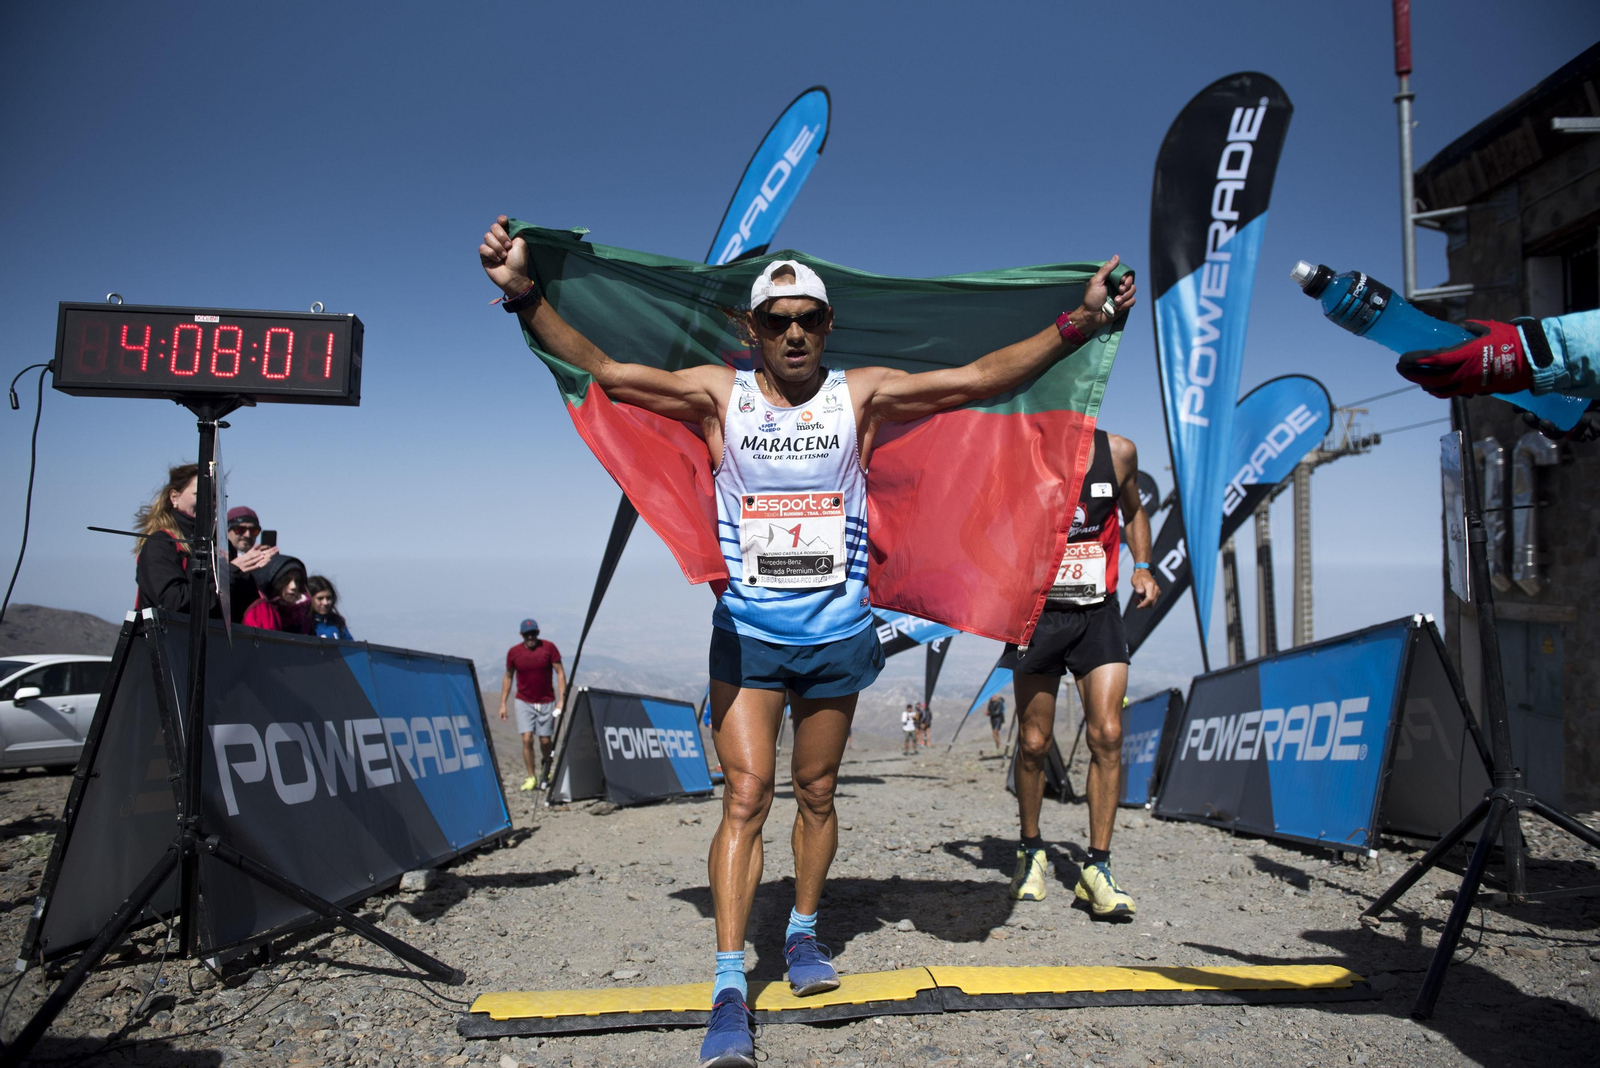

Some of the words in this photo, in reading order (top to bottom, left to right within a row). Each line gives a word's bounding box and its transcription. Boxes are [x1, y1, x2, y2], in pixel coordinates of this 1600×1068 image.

[715, 125, 816, 265] RADE
[1179, 104, 1267, 427] POWERADE
[1353, 272, 1367, 298] POWE
[121, 324, 334, 379] 4:08:01
[740, 434, 840, 453] MARACENA
[788, 523, 802, 548] 1
[759, 558, 802, 566] Mercedes-Benz
[760, 566, 785, 575] Granada
[786, 567, 813, 575] Premium
[604, 727, 699, 761] POWERADE
[1181, 697, 1369, 761] POWERADE
[208, 715, 480, 817] POWERADE
